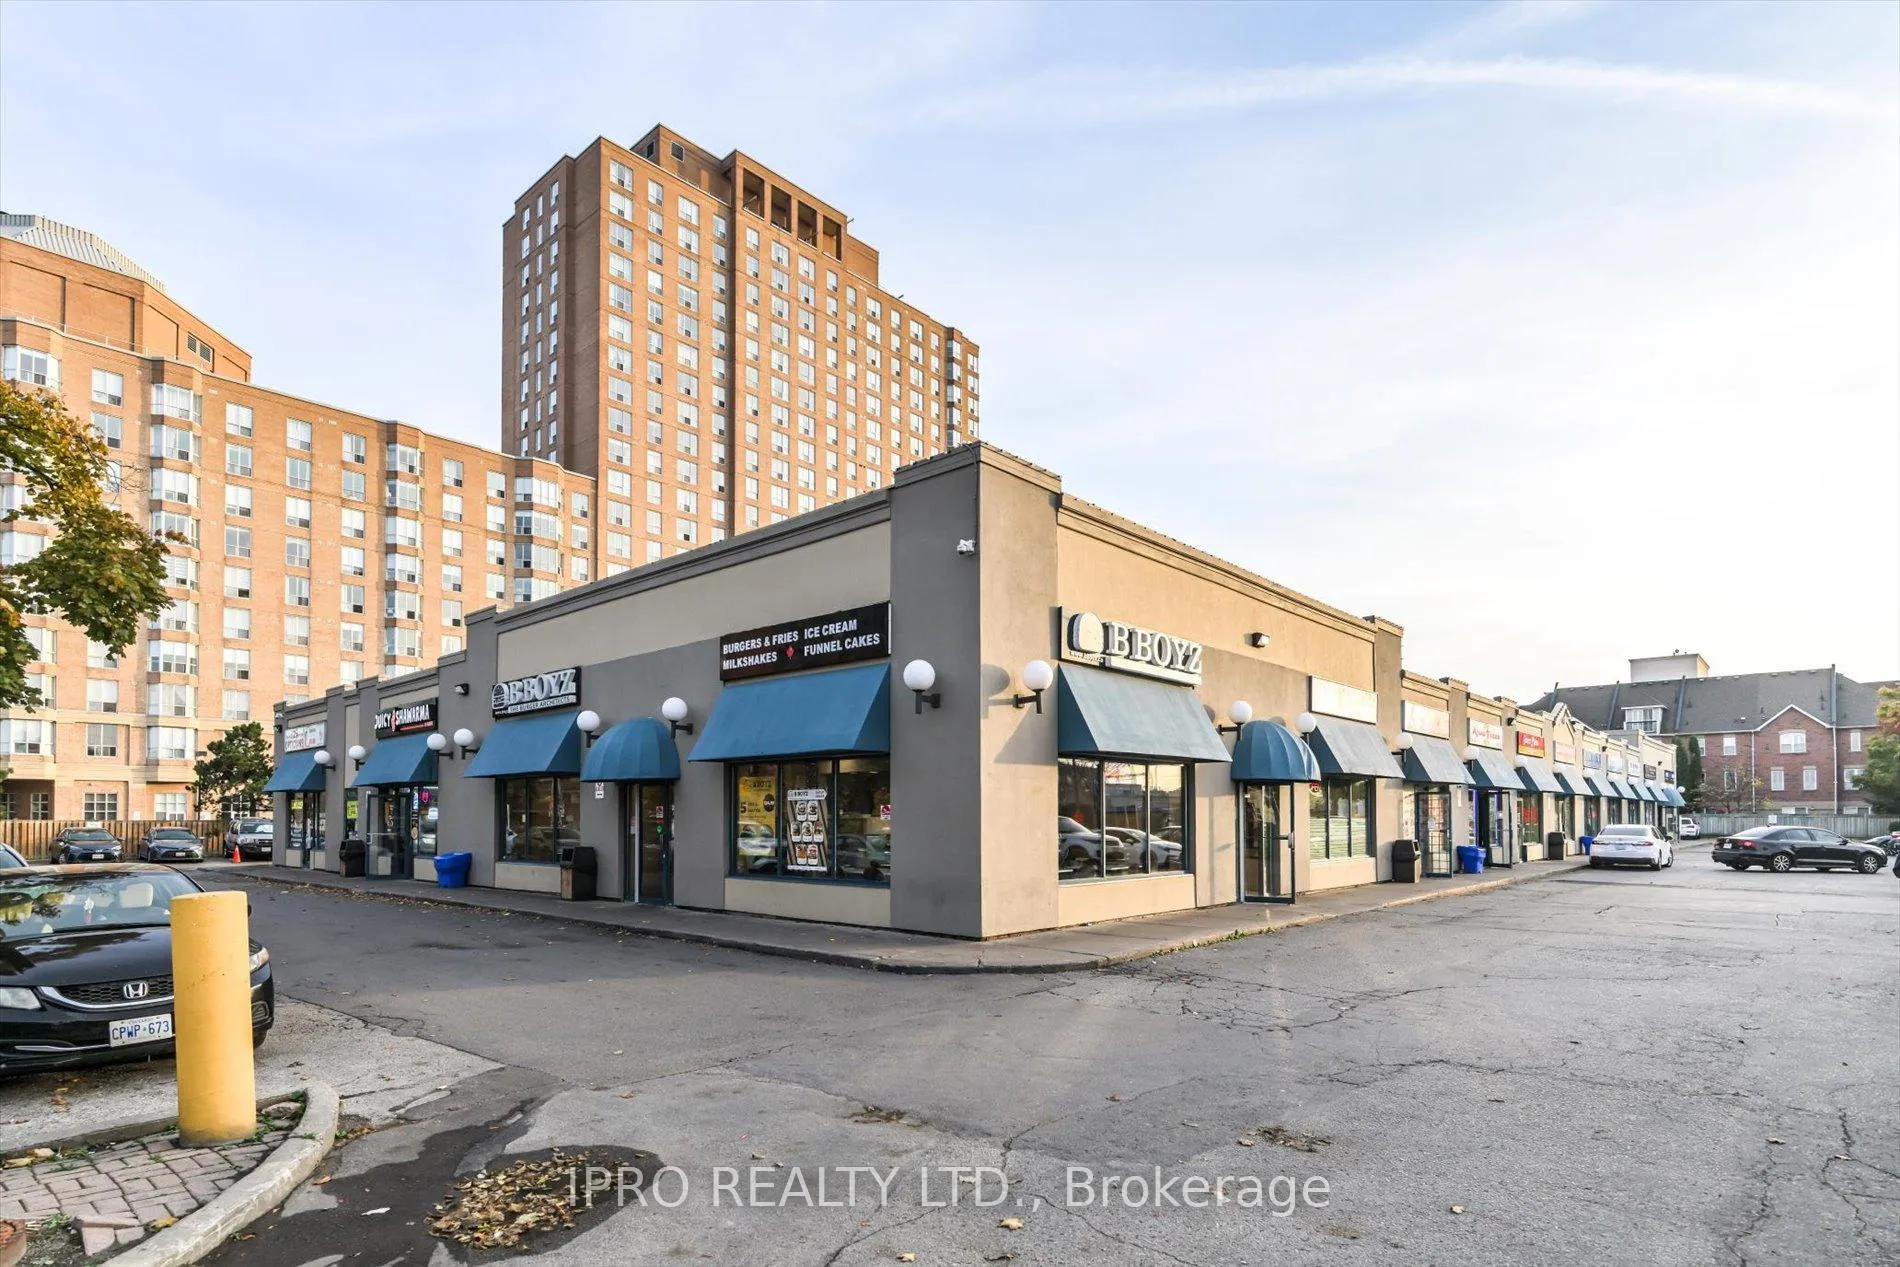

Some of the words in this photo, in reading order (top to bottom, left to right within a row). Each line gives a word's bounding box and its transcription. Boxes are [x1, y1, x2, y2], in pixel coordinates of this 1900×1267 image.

[804, 626, 820, 640] ICE
[822, 619, 857, 636] CREAM
[723, 638, 762, 655] BURGERS
[764, 636, 770, 647] &
[772, 630, 799, 646] FRIES
[804, 640, 843, 657] FUNNEL
[844, 633, 880, 650] CAKES
[1104, 621, 1202, 675] BBOYZ
[722, 651, 778, 670] MILKSHAKES
[508, 669, 576, 704] BBOYZ
[374, 713, 391, 730] JUICY
[395, 704, 430, 726] SHAWARMA
